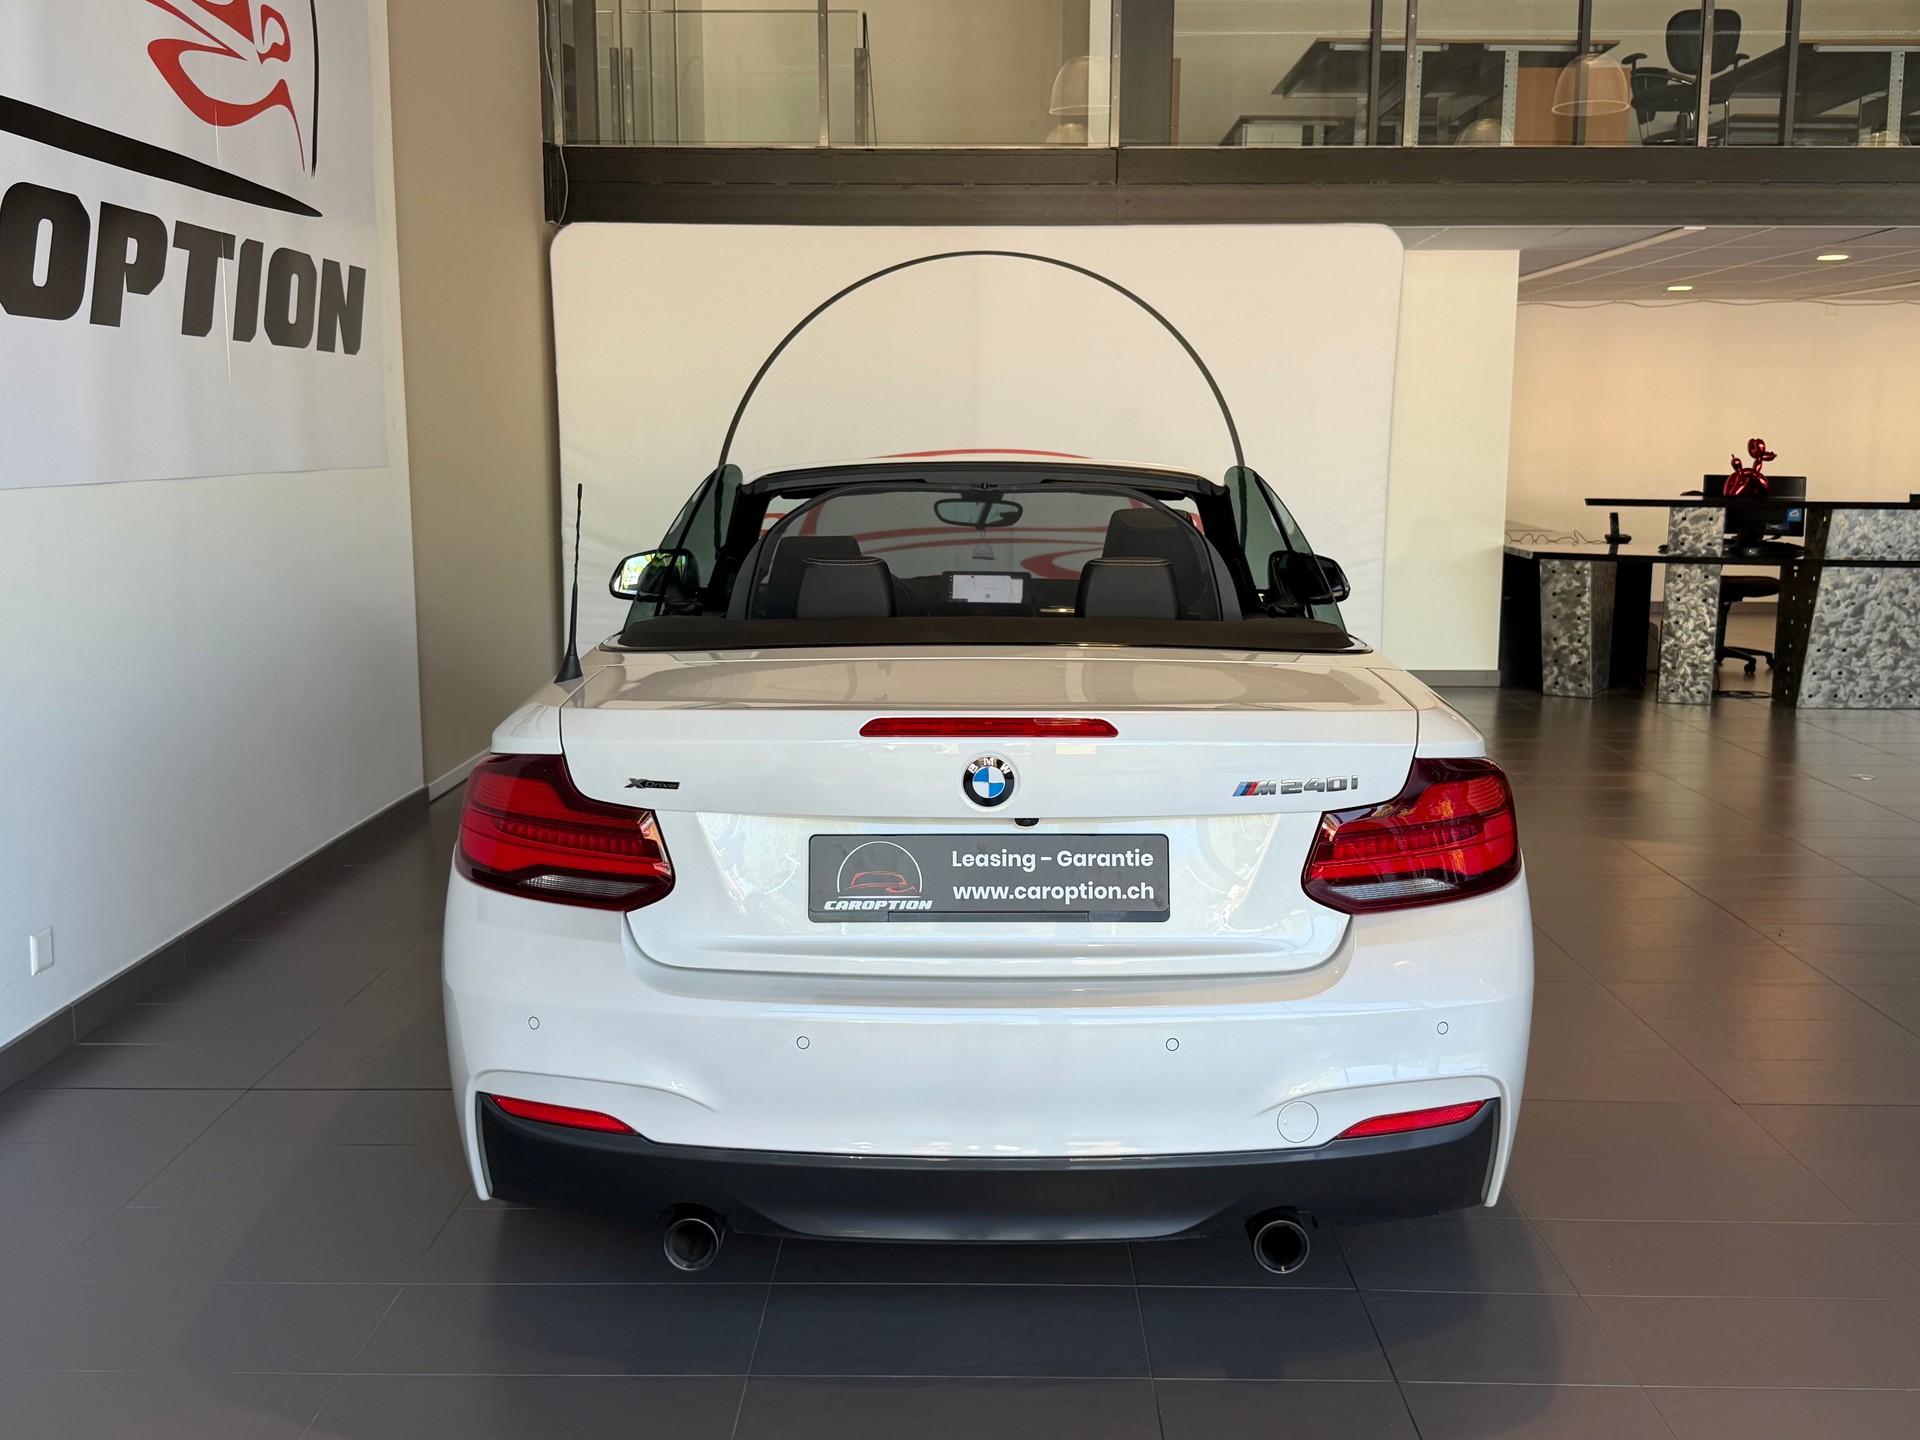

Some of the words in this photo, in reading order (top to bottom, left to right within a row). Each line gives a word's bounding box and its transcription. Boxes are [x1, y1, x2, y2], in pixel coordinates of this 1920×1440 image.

[0, 181, 366, 356] OPTION
[967, 757, 1012, 774] BMW
[952, 848, 1036, 873] Leasing
[1056, 848, 1154, 868] Garantie
[823, 900, 933, 910] CAROPTION
[953, 881, 1155, 905] www.caroption.ch
